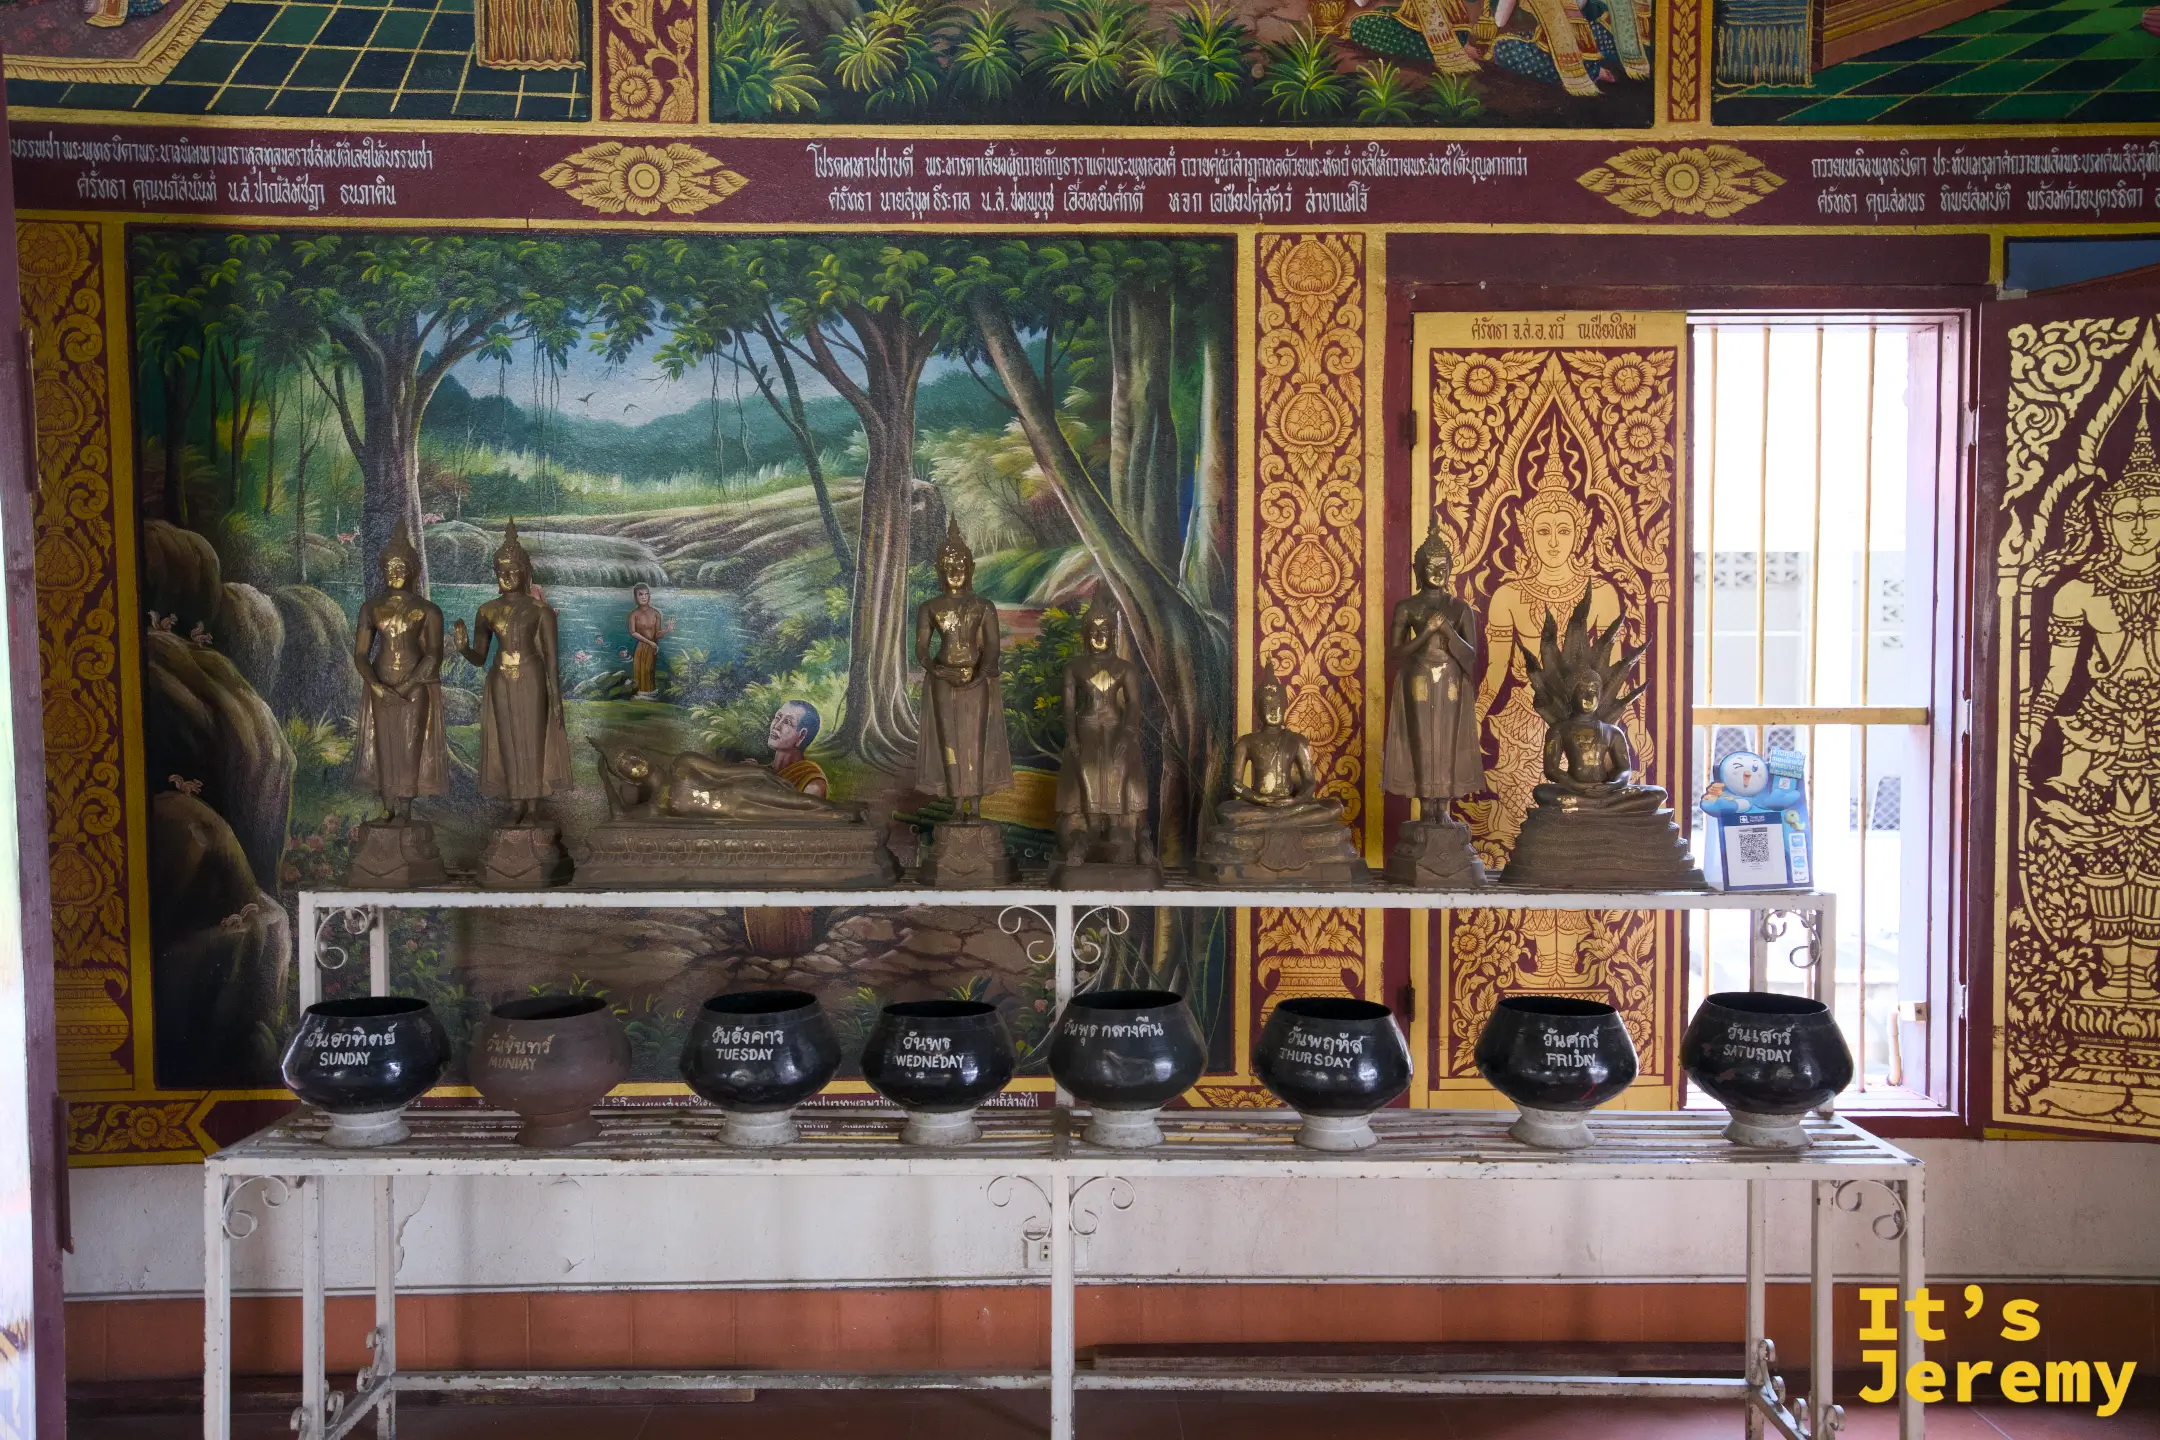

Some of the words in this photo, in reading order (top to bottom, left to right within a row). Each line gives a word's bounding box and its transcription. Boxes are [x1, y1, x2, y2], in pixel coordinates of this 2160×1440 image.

[1933, 140, 2160, 182] ประทับเมรุมาศถวายเพลิงพระบรมศพสิริสุทโ
[77, 170, 126, 200] ศรัทธา
[340, 175, 396, 205] ธนภาคิน
[829, 185, 872, 211] ศรัทธา
[881, 187, 929, 219] นายสุขุม
[1210, 182, 1292, 220] เอเชียปศุสัตว์
[1305, 181, 1370, 213] สาขาแม่โจ้
[1818, 184, 1858, 213] ศรัทธา
[1866, 188, 1925, 222] คุณสมพร
[1940, 181, 2011, 213] ทิพย์สมบัติ
[2027, 180, 2143, 217] พร้อมด้วยบุตรธิดา
[1472, 315, 1507, 340] ศรัทธา
[305, 1022, 397, 1048] วันอาทิตย์
[486, 1032, 556, 1055] วันจันทร์
[712, 1026, 784, 1045] วันอังคาร
[1288, 1026, 1363, 1055] วันพฤหัส
[1728, 1023, 1795, 1045] วันเสาร์
[320, 1051, 370, 1066] SUNDAY
[716, 1048, 773, 1061] TUESDAY
[1279, 1047, 1353, 1069] THURSDAY
[1546, 1053, 1597, 1067] FRIDAY
[1723, 1044, 1793, 1063] SATURDAY
